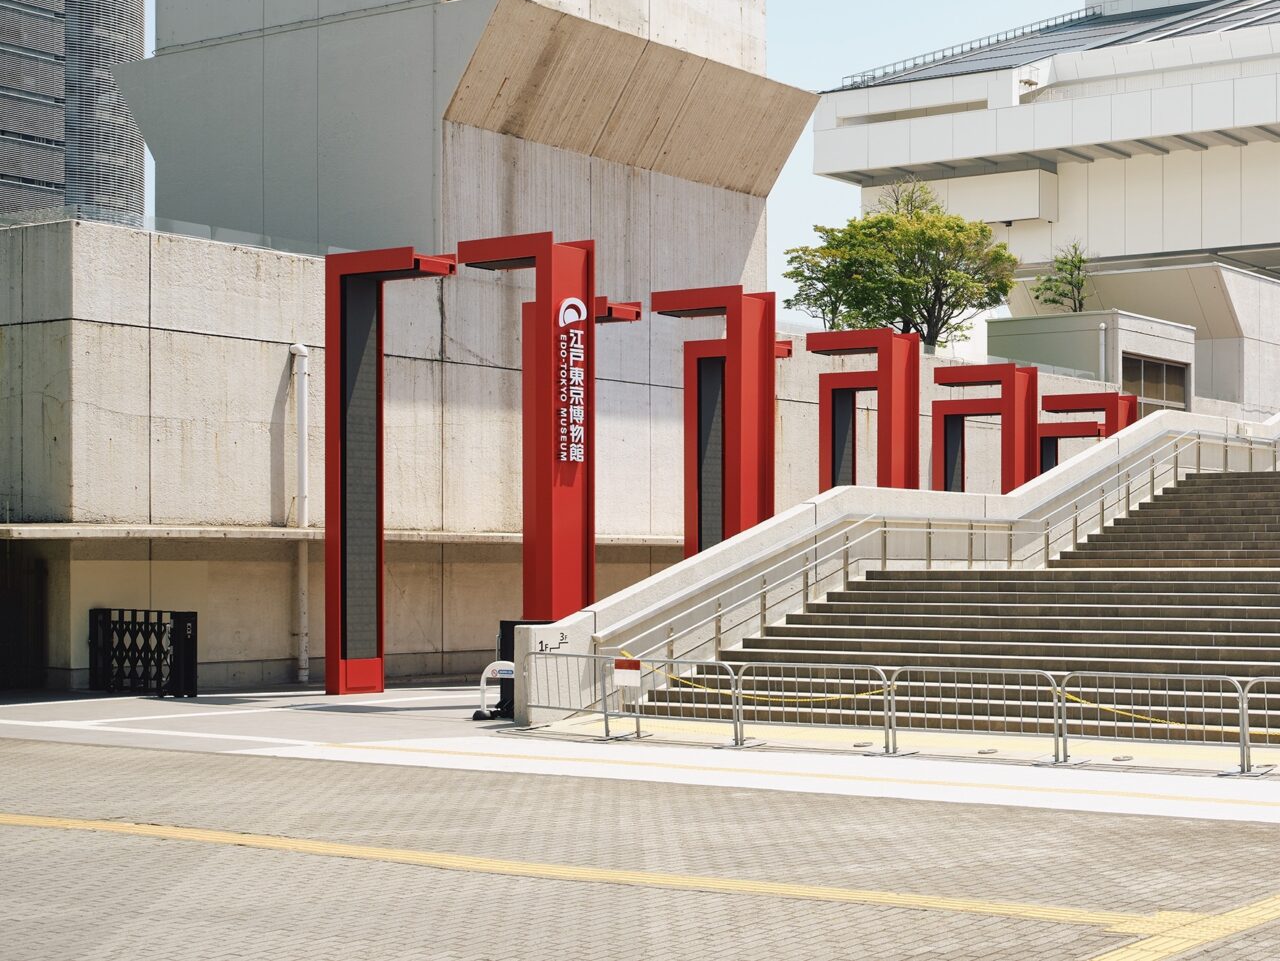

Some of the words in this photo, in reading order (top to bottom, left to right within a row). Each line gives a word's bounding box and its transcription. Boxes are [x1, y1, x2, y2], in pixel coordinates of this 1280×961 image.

[569, 328, 584, 462] 江戸東京博物館
[559, 632, 568, 641] 3F
[538, 640, 549, 652] 1F
